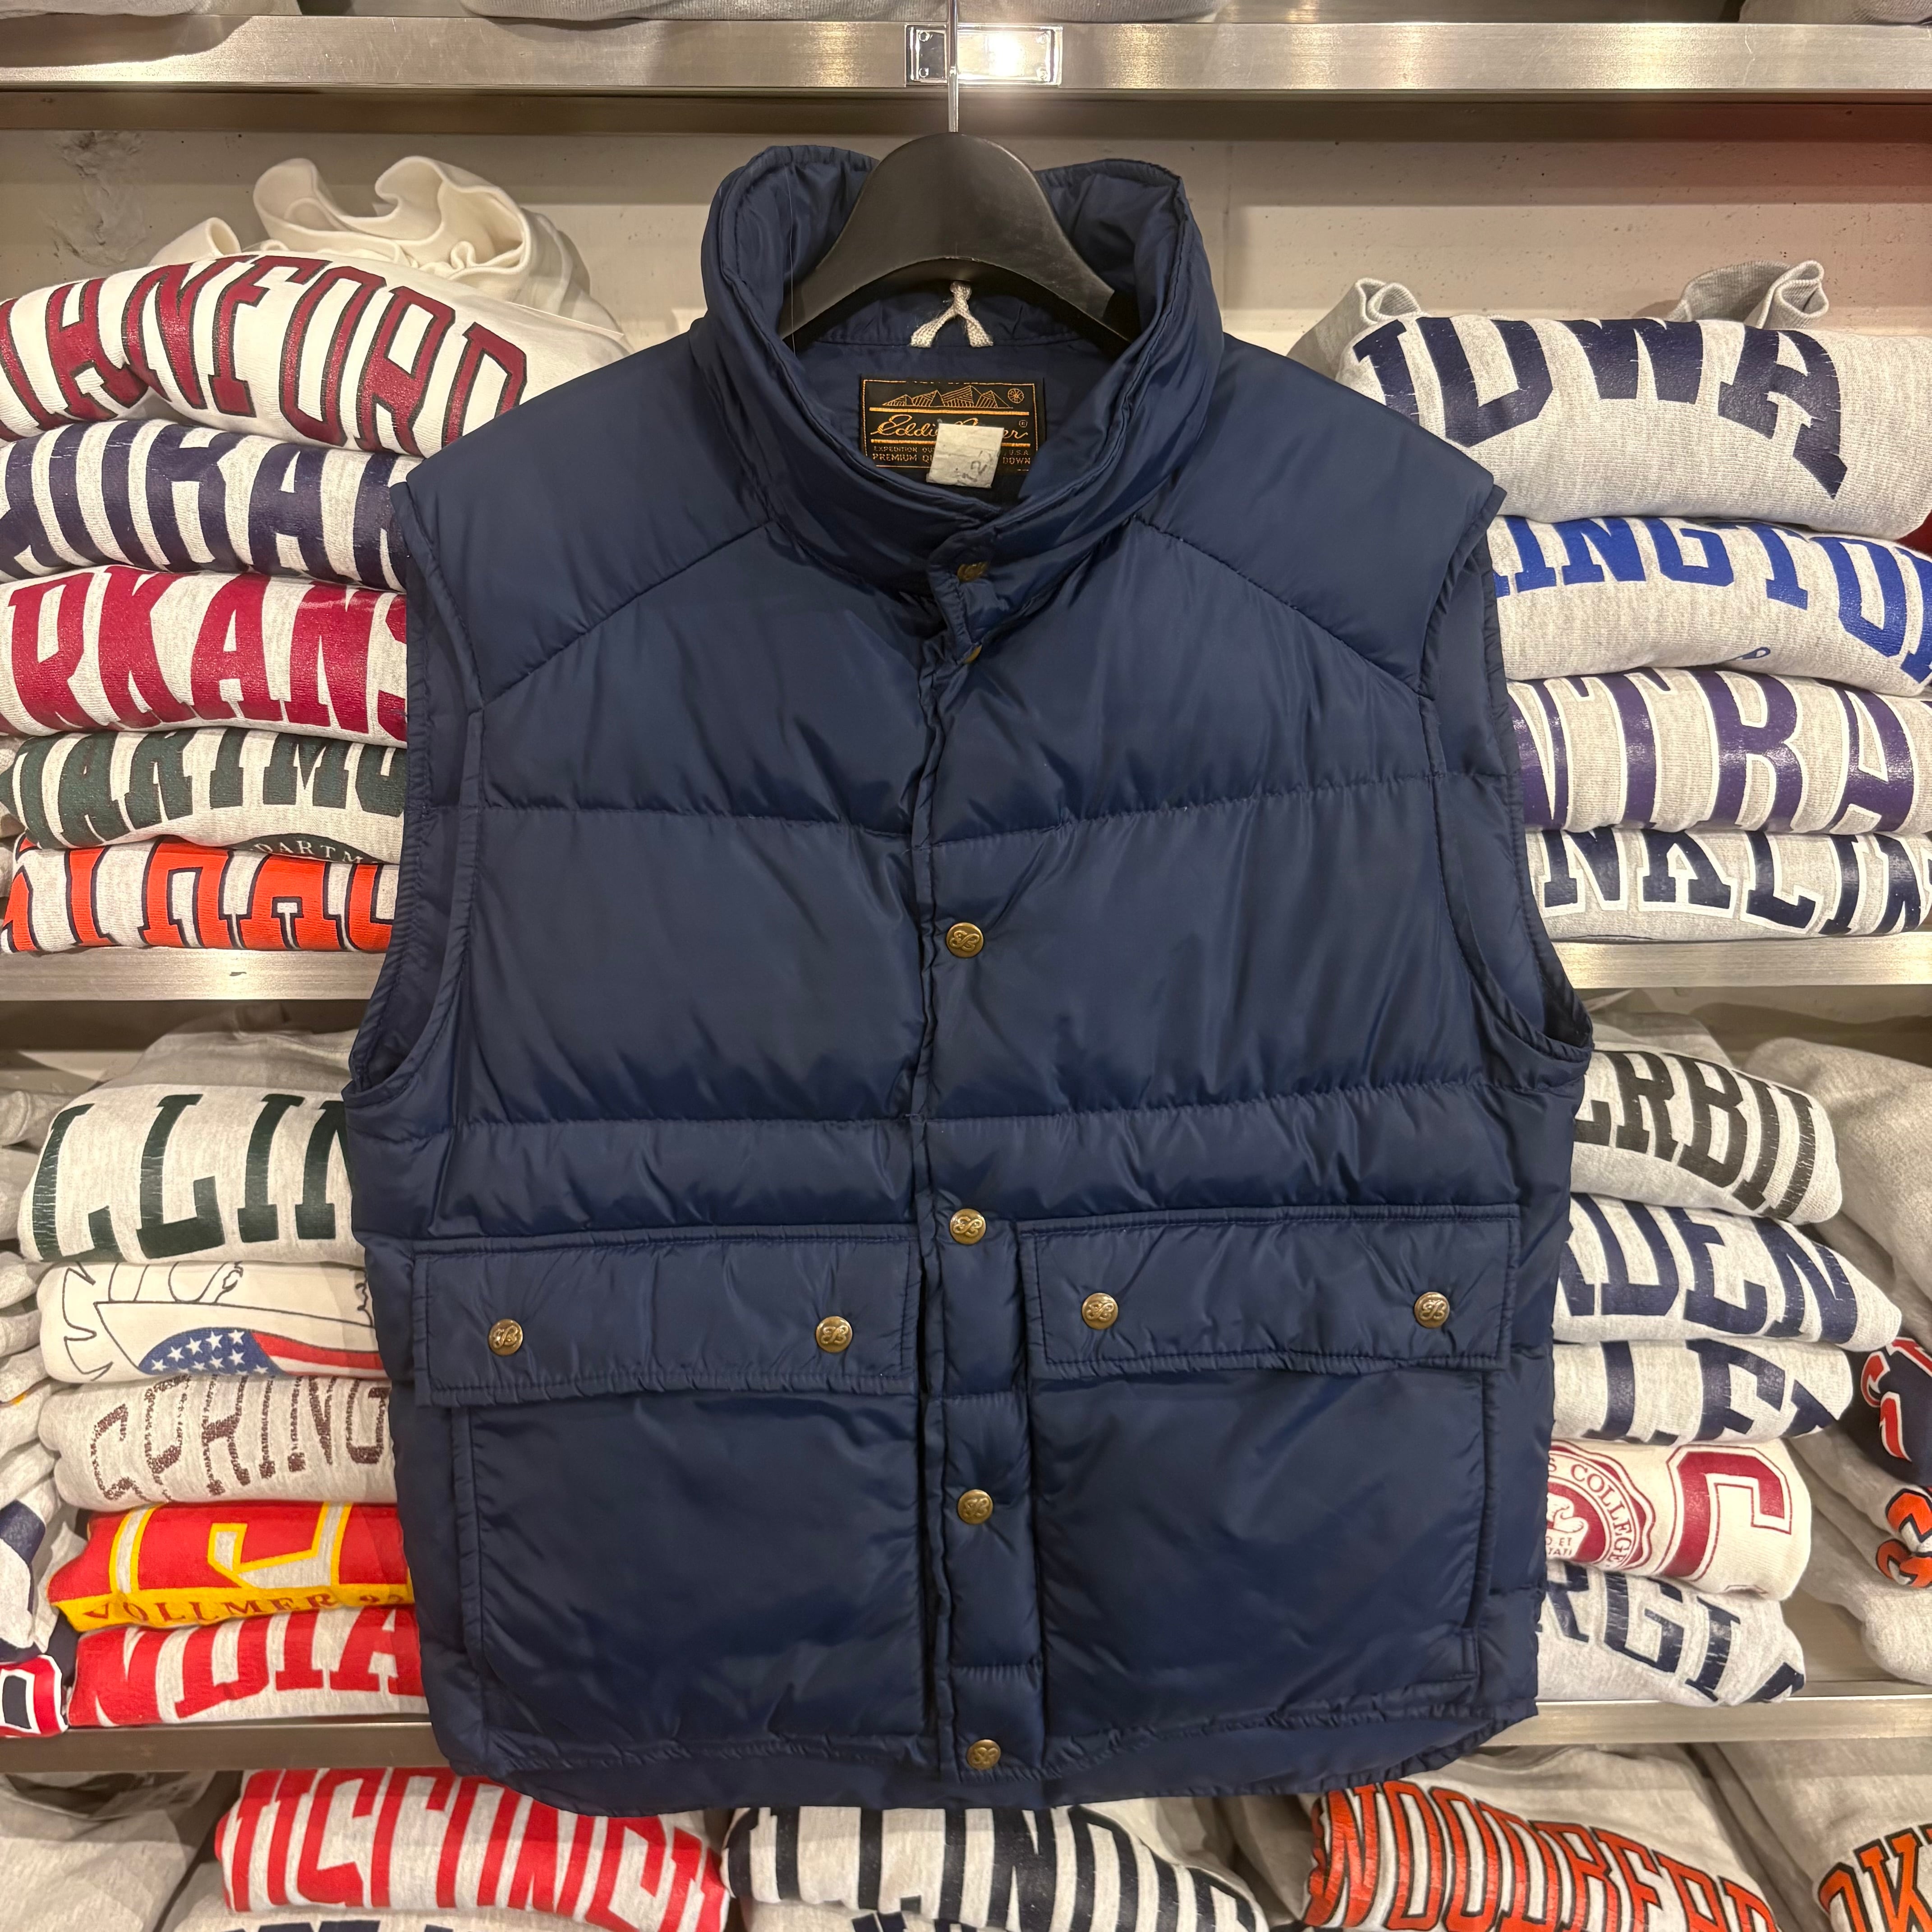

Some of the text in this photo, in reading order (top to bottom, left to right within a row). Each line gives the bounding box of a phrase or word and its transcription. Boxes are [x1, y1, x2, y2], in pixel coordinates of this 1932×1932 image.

[870, 414, 938, 437] Eddi
[872, 454, 917, 462] PREMIUM
[1570, 1463, 1633, 1564] COLLEGE
[83, 1592, 340, 1622] VOLLMER
